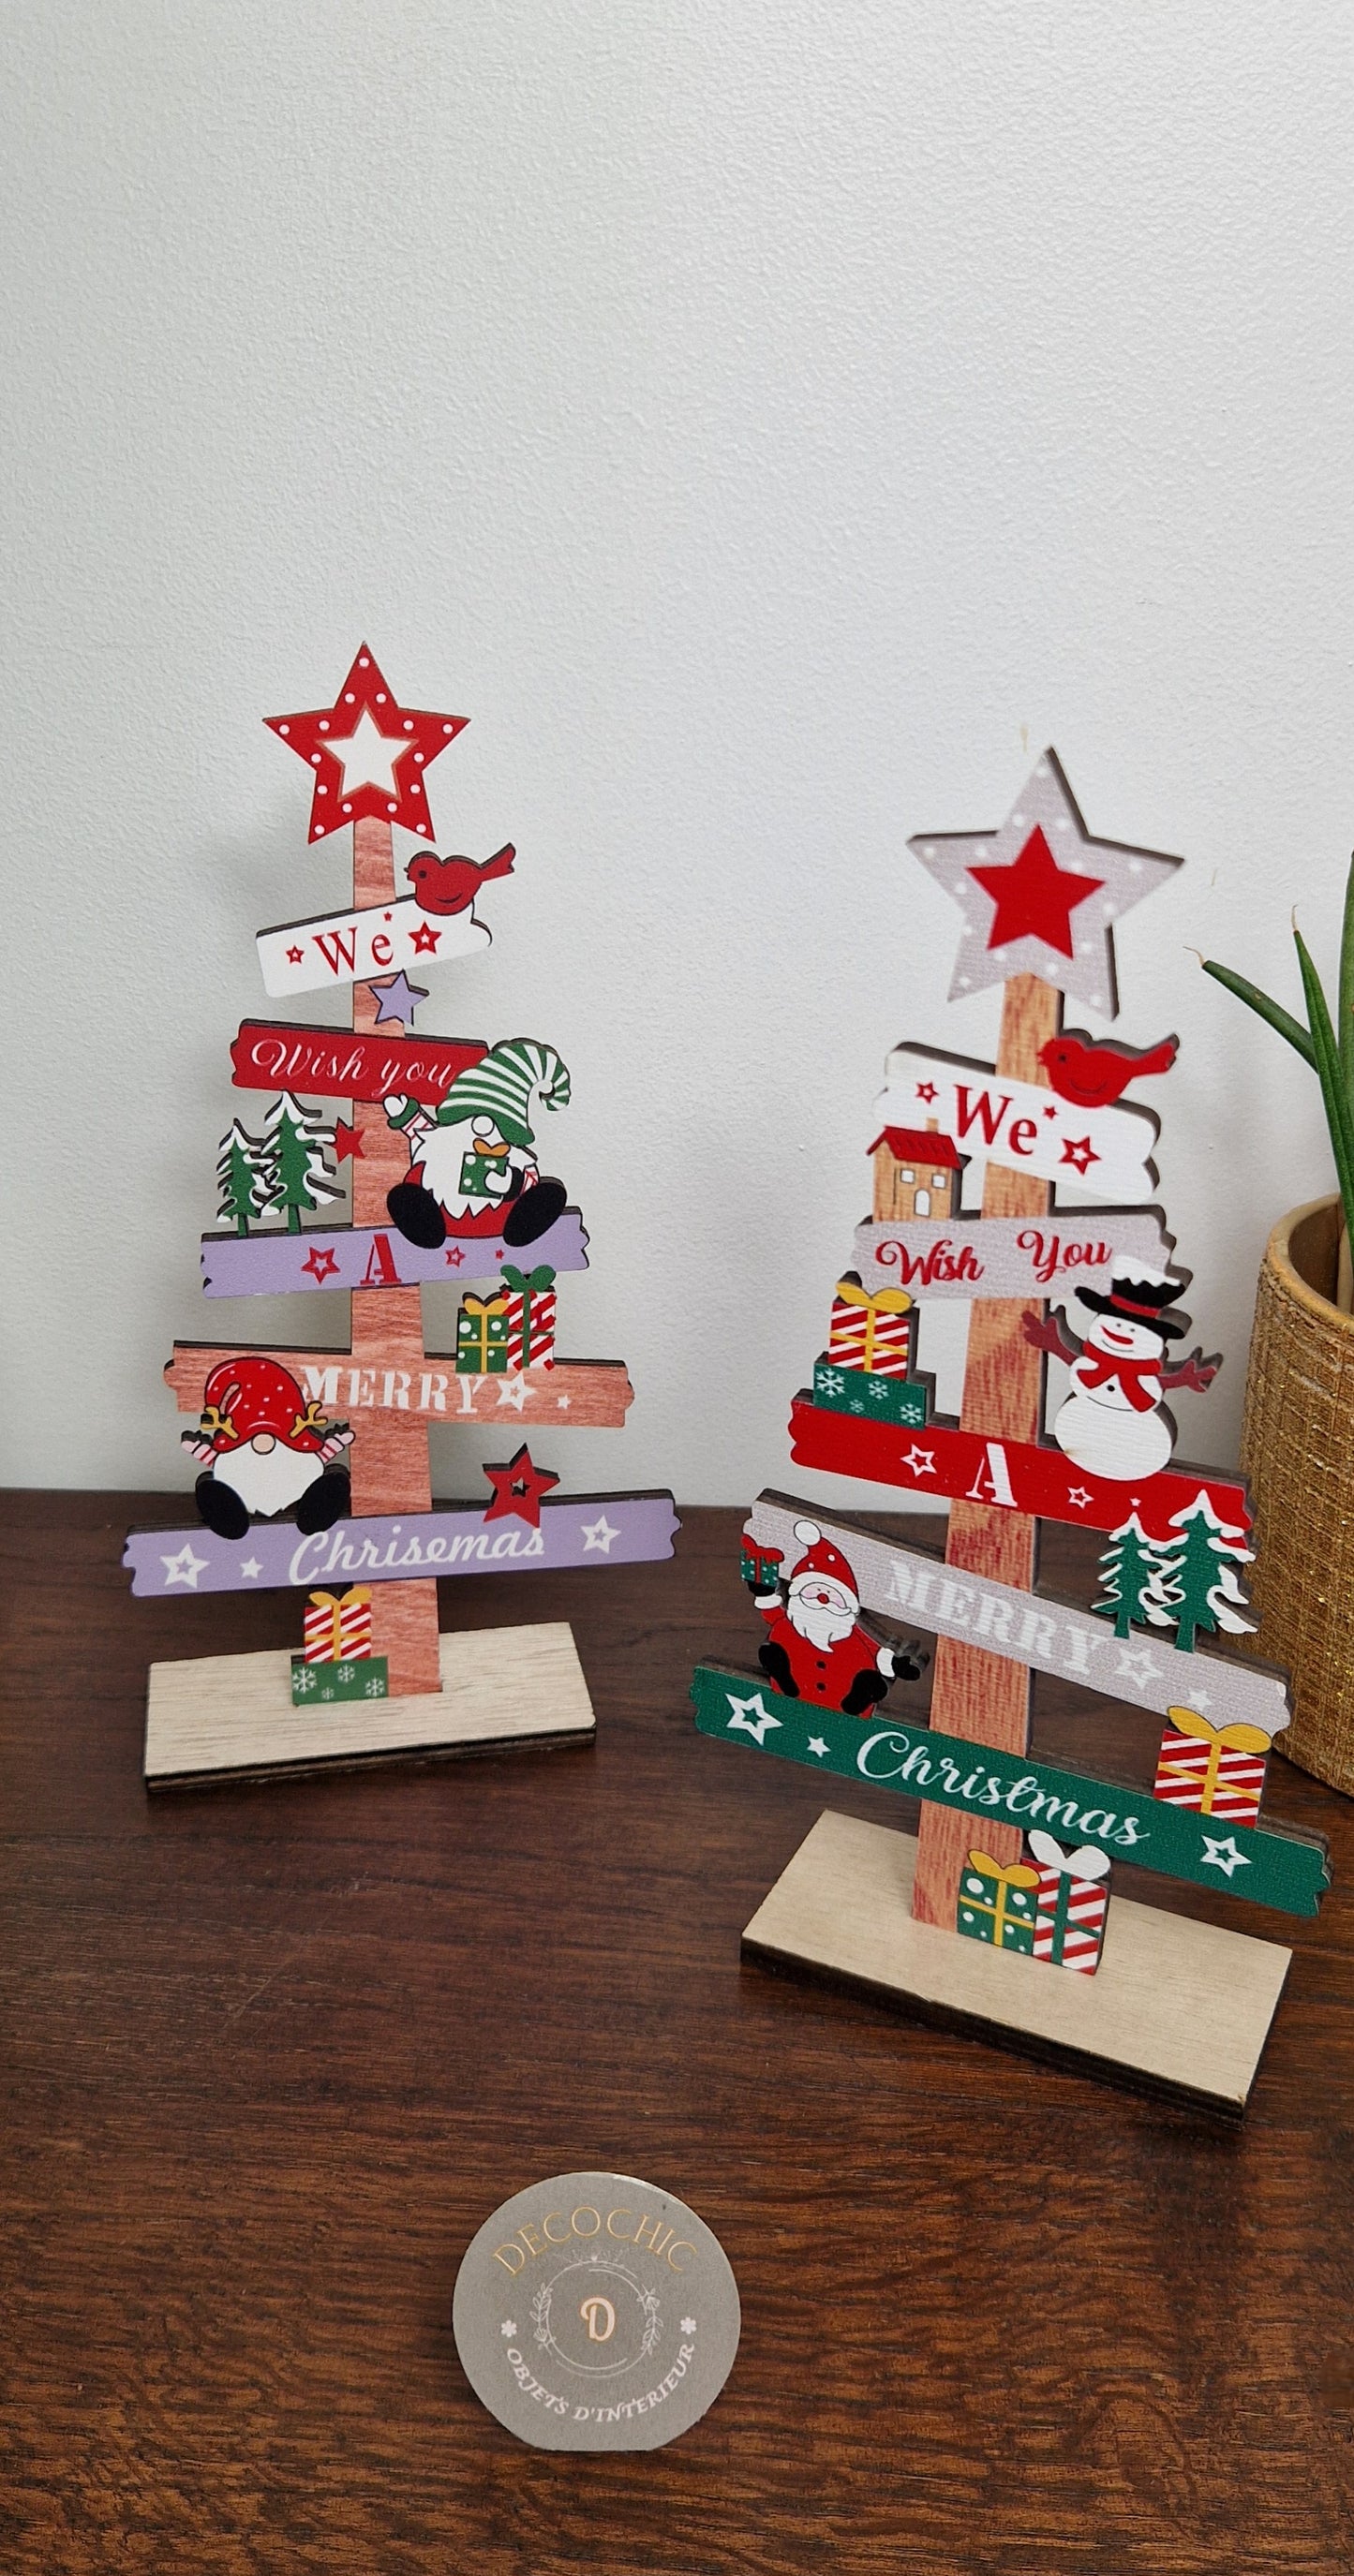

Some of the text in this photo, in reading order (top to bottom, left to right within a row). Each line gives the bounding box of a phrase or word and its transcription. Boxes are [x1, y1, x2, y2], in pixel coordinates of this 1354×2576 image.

[312, 926, 394, 976] We
[250, 1038, 458, 1098] Wish you
[953, 1084, 1038, 1156] We
[360, 1234, 402, 1285] A
[875, 1229, 1112, 1285] Wish You
[301, 1366, 491, 1414] MERRY
[965, 1443, 1017, 1507] A
[885, 1560, 1114, 1675] MERRY
[856, 1731, 1150, 1845] Christmas
[492, 2207, 698, 2275] DECOCHIC
[580, 2297, 615, 2342] D
[507, 2348, 569, 2415] OBJETS
